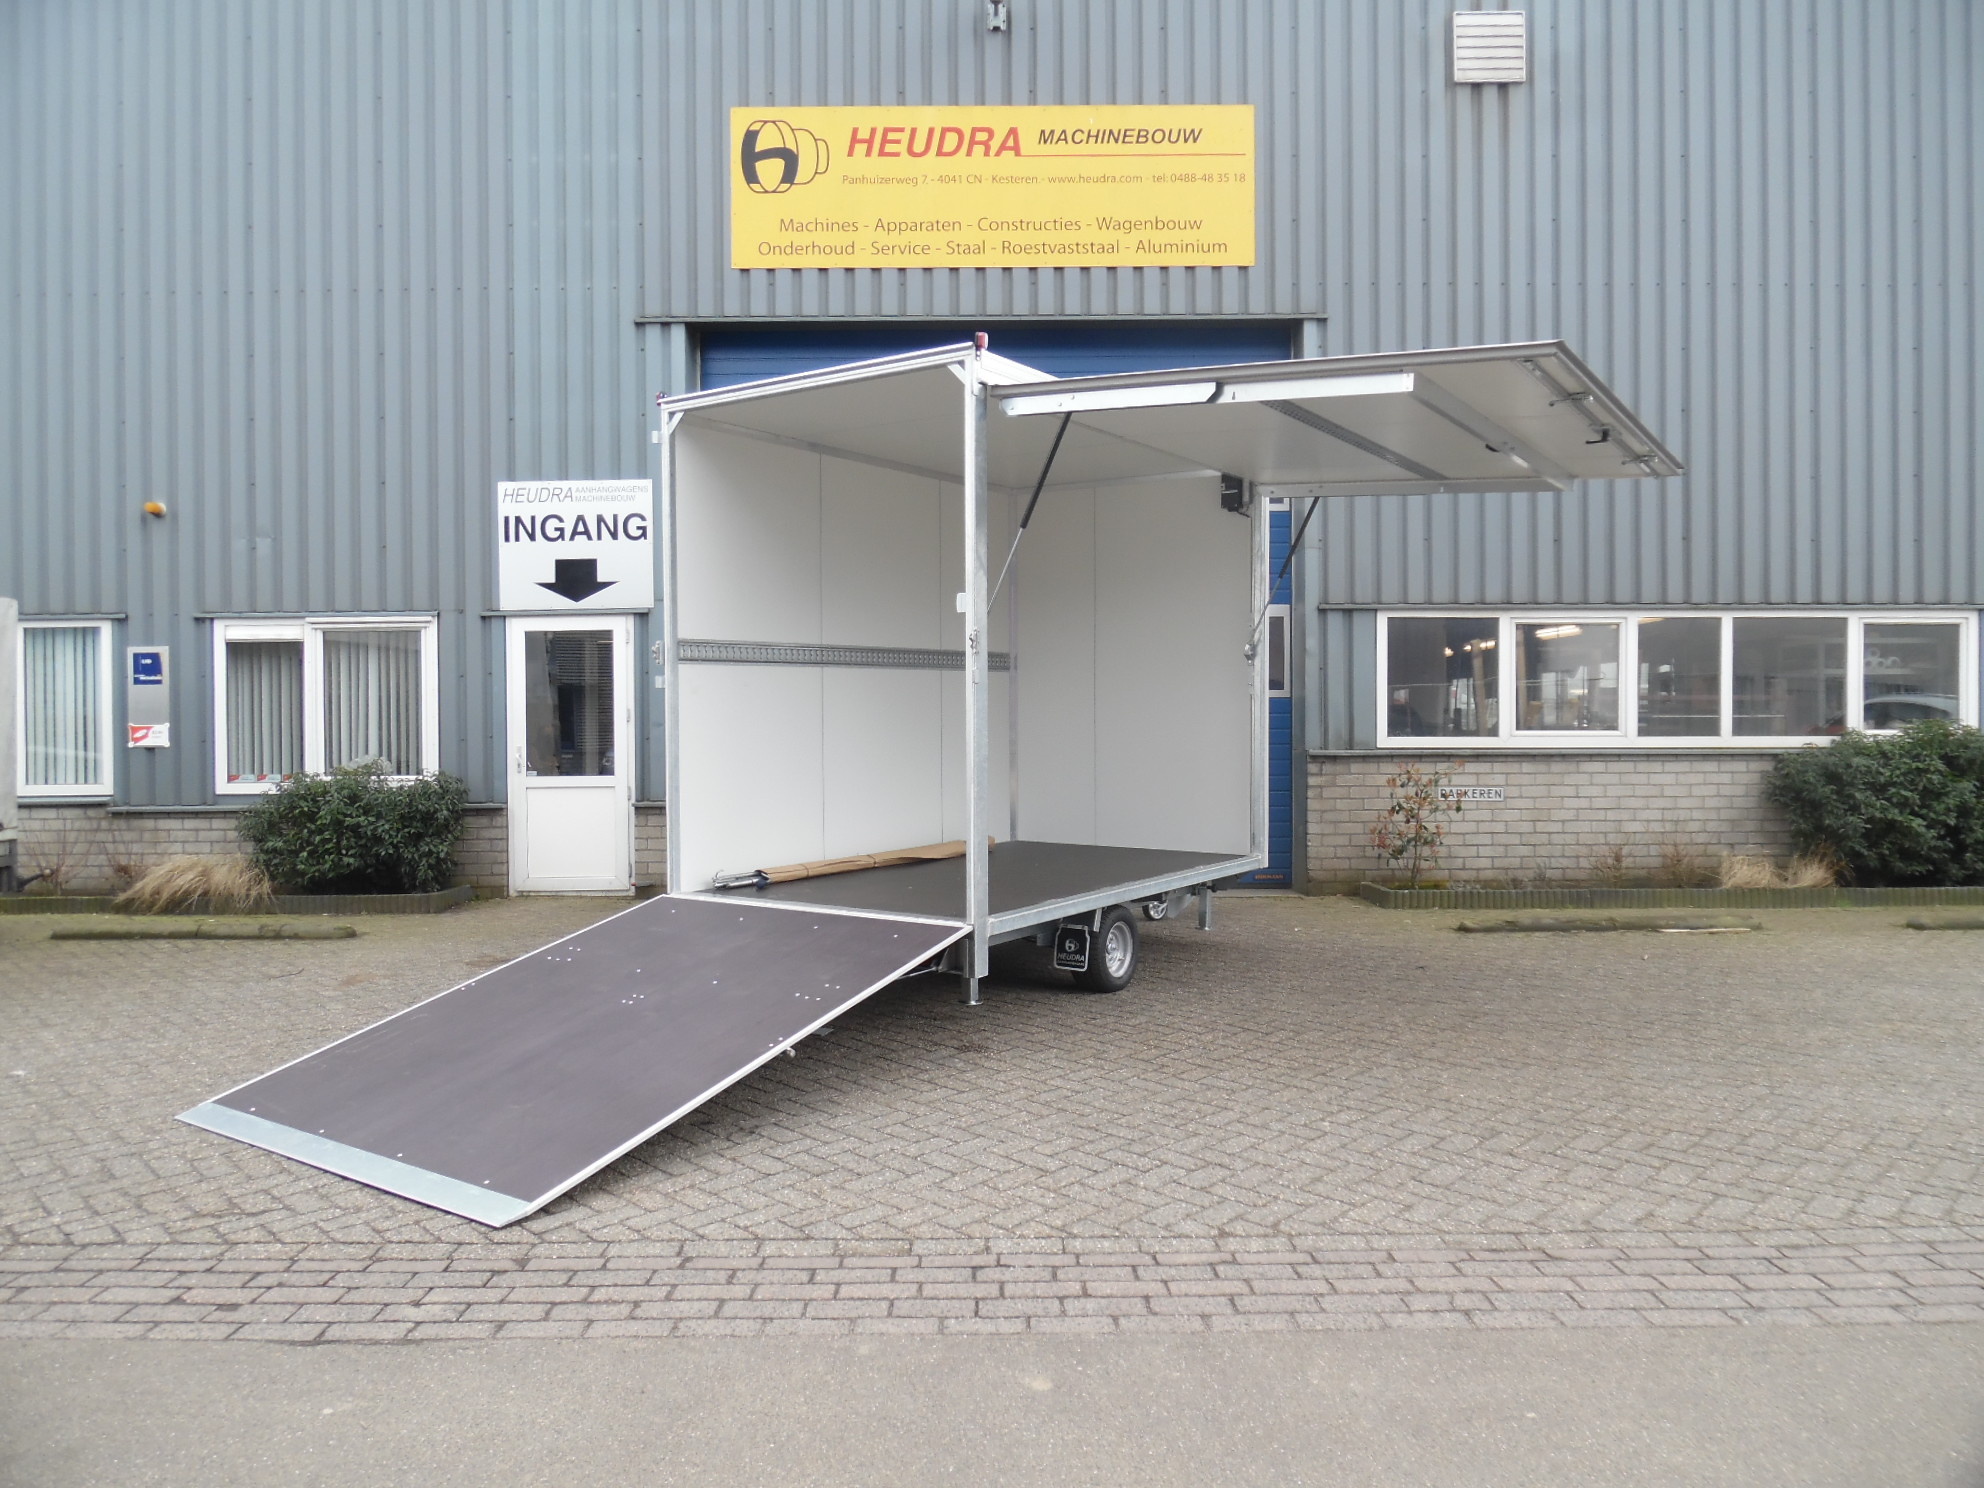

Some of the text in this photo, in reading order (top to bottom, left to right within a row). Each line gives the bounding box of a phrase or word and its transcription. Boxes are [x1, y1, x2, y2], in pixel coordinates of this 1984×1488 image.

[847, 126, 1203, 158] HEUDRA MACHINEBOUW
[842, 174, 918, 188] Panhuizerweg
[937, 174, 963, 184] 4041
[966, 174, 983, 184] CN
[1048, 173, 1143, 184] www.heudra.com
[1170, 173, 1214, 183] 0488-48
[1217, 173, 1230, 183] 35
[1234, 173, 1246, 183] 18
[779, 218, 859, 233] Machines
[874, 218, 962, 236] Apparaten
[977, 217, 1082, 232] Constructies
[1096, 216, 1203, 235] Wagenbouw
[758, 241, 855, 256] Onderhoud
[871, 241, 931, 256] Service
[946, 240, 986, 256] Staal
[1001, 239, 1120, 255] Roestvaststaal
[1135, 239, 1228, 254] Aluminium
[503, 487, 573, 503] HEUDRA
[504, 513, 648, 542] INGANG
[1057, 953, 1085, 962] HEUDRA
